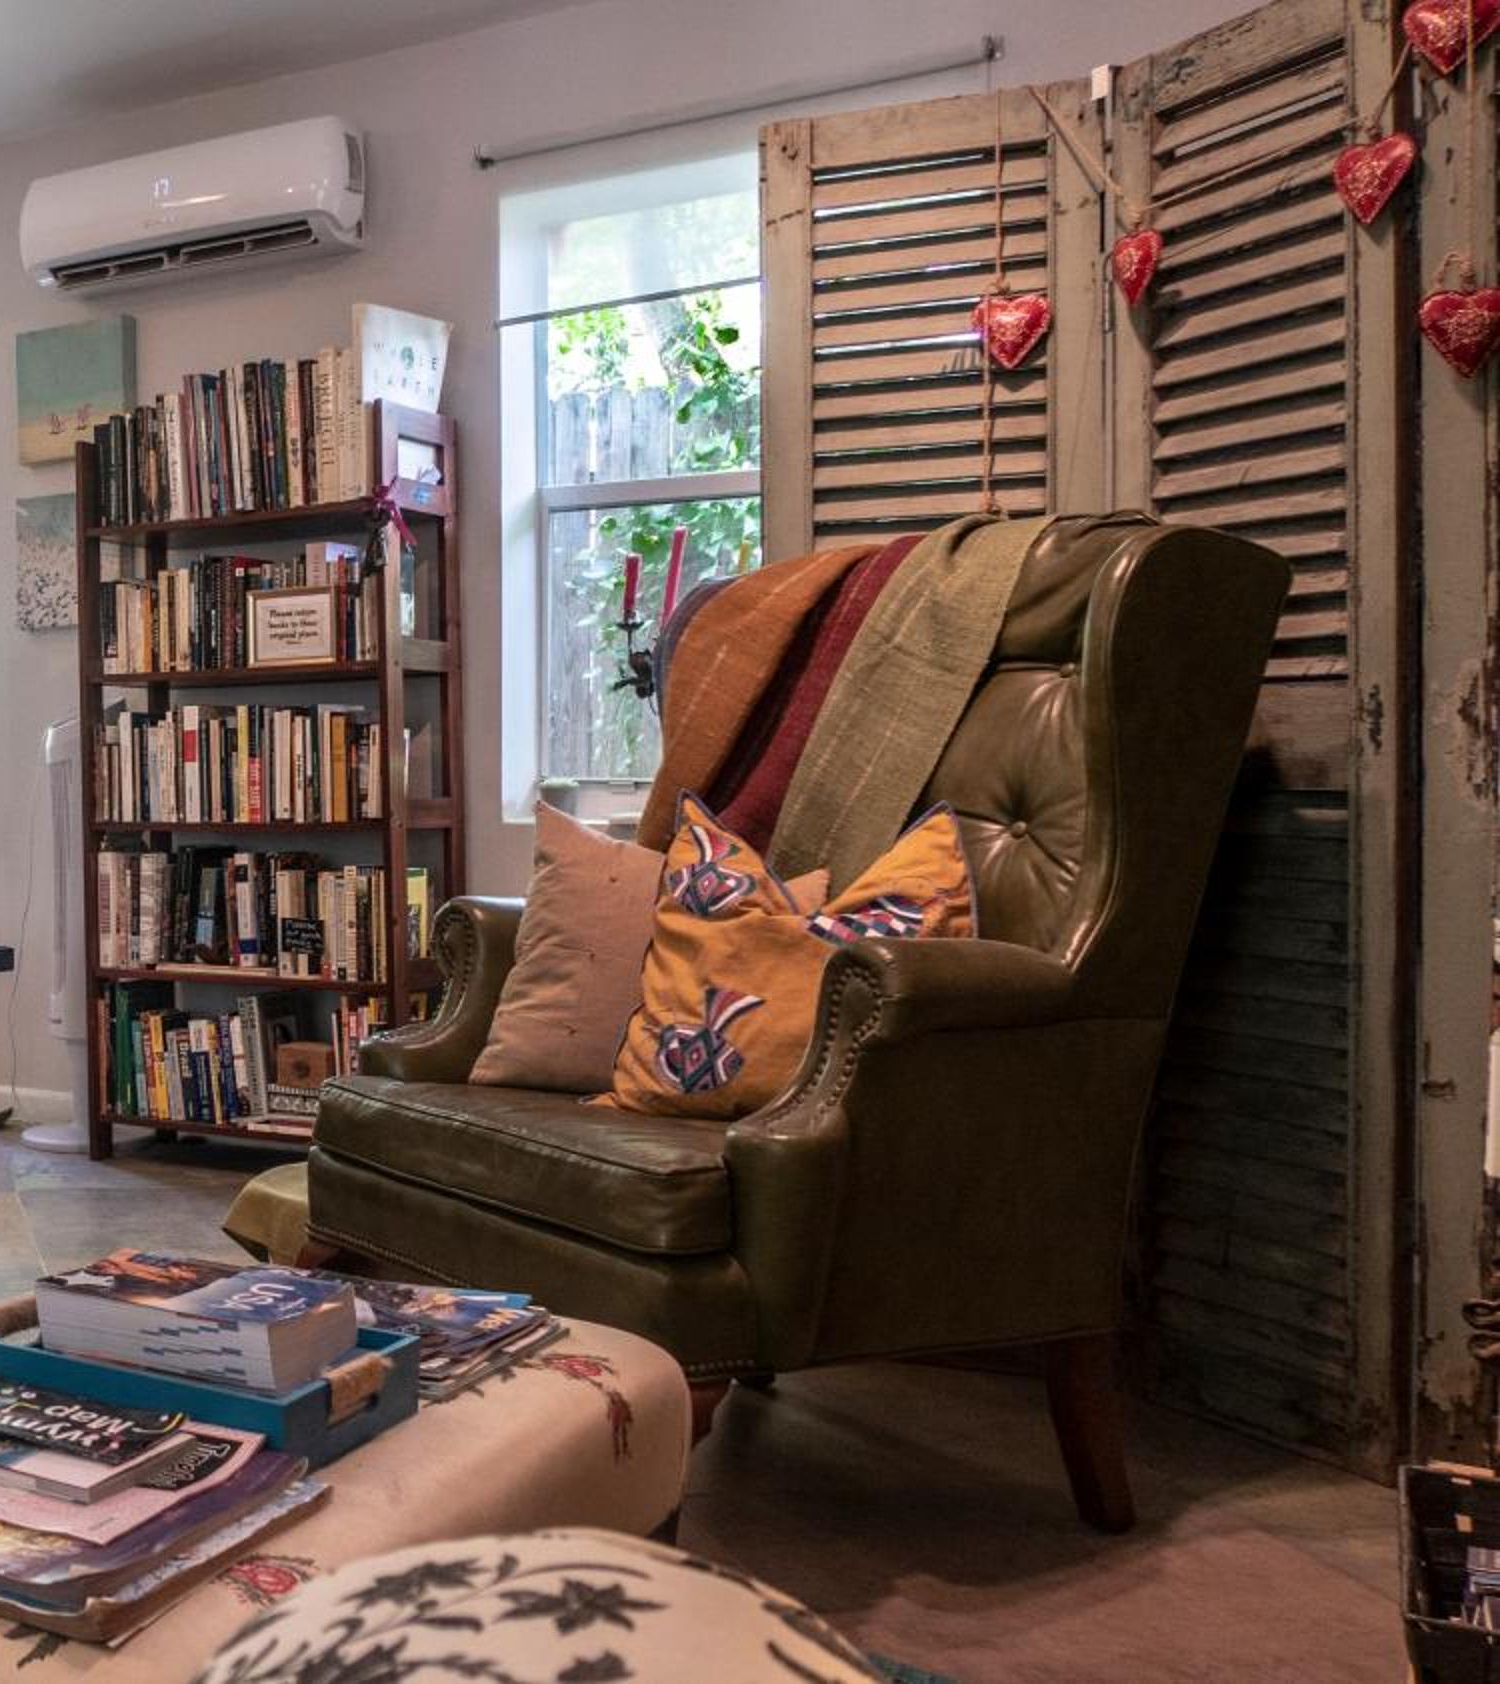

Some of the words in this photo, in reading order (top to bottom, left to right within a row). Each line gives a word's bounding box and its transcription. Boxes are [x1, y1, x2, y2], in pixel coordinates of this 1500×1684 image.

[269, 609, 292, 618] Please
[268, 620, 289, 629] books
[269, 630, 296, 640] original
[210, 1283, 296, 1311] USA
[43, 1404, 135, 1437] Map
